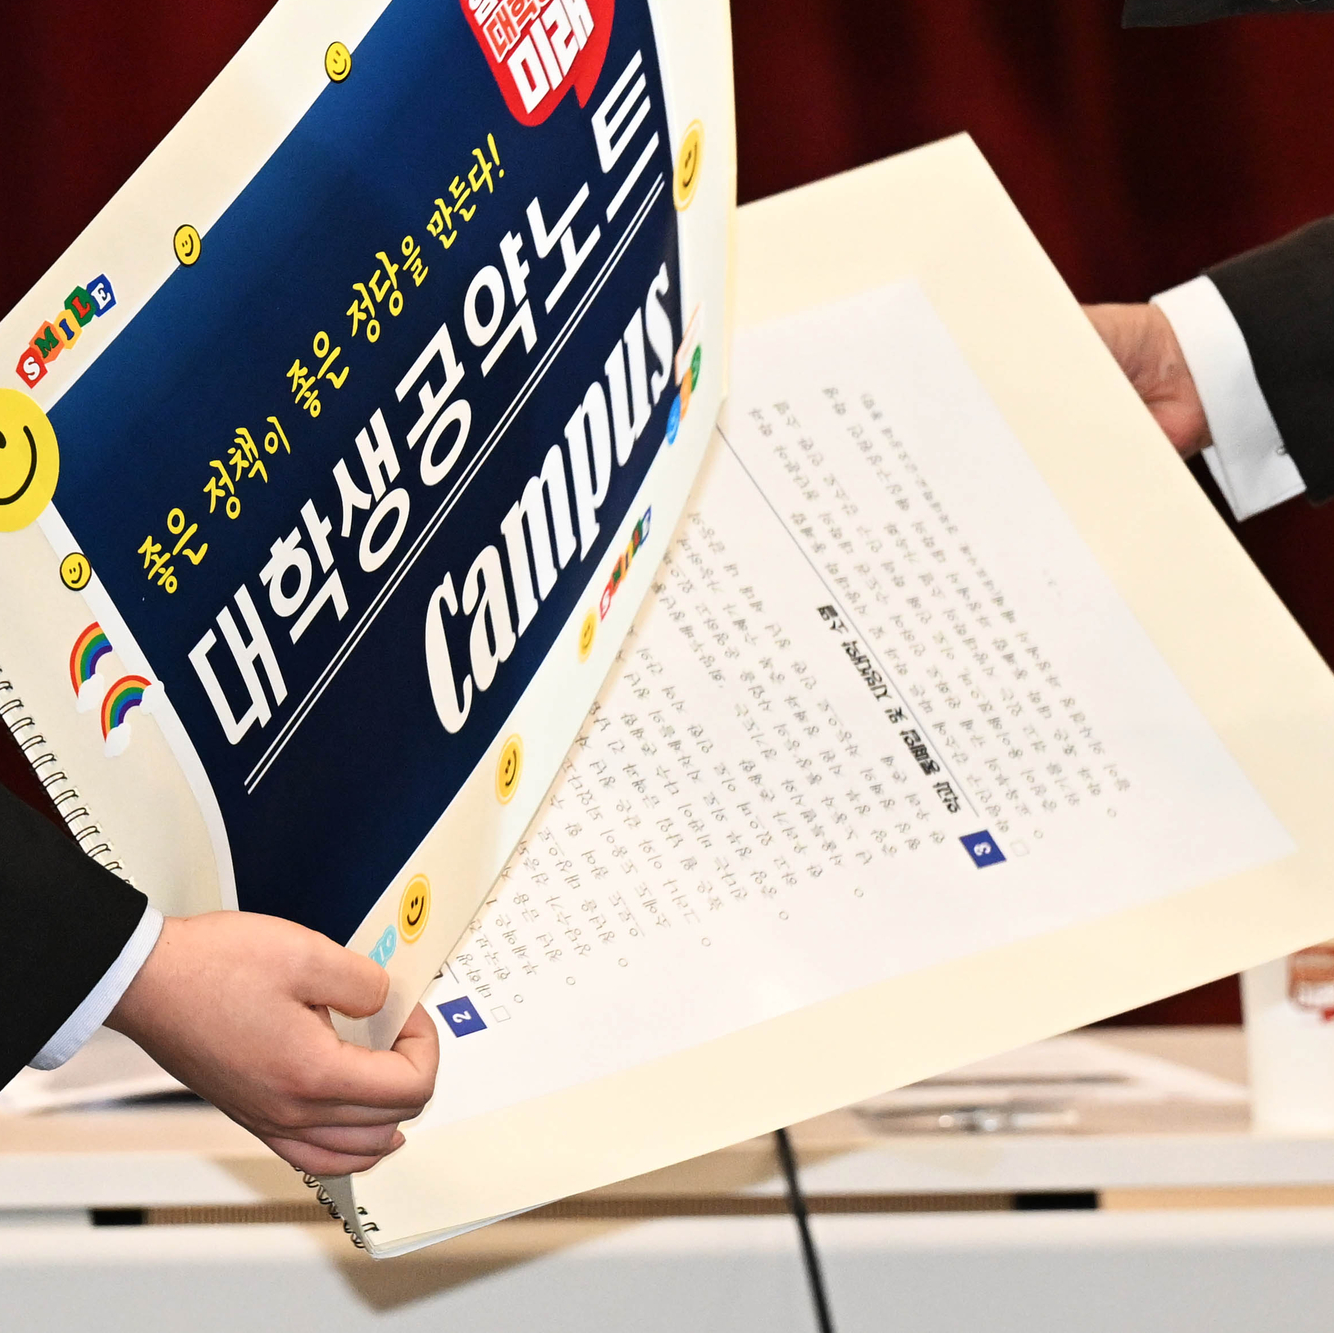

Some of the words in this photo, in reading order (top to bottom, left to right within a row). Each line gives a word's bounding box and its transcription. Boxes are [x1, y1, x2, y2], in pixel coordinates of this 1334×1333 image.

[21, 280, 113, 383] SMILE
[138, 508, 208, 593] 좋은
[203, 416, 291, 520] 정책이
[286, 331, 350, 418] 좋은
[345, 235, 429, 343] 정당을
[426, 133, 505, 249] 만든다!
[188, 50, 660, 746] 대학생공약노트
[424, 261, 674, 735] Campus
[816, 603, 846, 631] 소멸
[622, 672, 650, 699] 청년
[840, 639, 889, 701] 지방대학
[883, 705, 905, 724] 및
[898, 728, 941, 776] 통폐합
[588, 760, 616, 788] 청년
[621, 762, 660, 805] 금액과
[655, 764, 680, 796] 다수
[712, 762, 736, 792] 이로
[549, 793, 566, 808] 수
[614, 798, 642, 828] 같은
[931, 780, 961, 814] 학과
[563, 822, 583, 837] 할
[654, 816, 684, 849] 납입
[676, 802, 713, 849] 비판이
[735, 800, 773, 847] 있으며
[536, 830, 581, 890] 대상으로
[579, 848, 609, 879] 참여
[598, 828, 638, 875] 도움이
[637, 838, 663, 870] 이와
[973, 841, 993, 859] 3
[715, 856, 748, 899] 진다는
[772, 857, 798, 885] 하고
[511, 891, 540, 919] 금융
[638, 885, 671, 927] 소에도
[661, 878, 695, 917] 그러나
[695, 879, 723, 911] 높은
[544, 895, 592, 956] 상당수가
[579, 899, 615, 942] 청년을
[611, 894, 645, 937] 으로도
[494, 917, 539, 975] 부채액은
[534, 932, 563, 961] 청년
[454, 952, 492, 999] 대학생
[452, 1010, 472, 1025] 2
